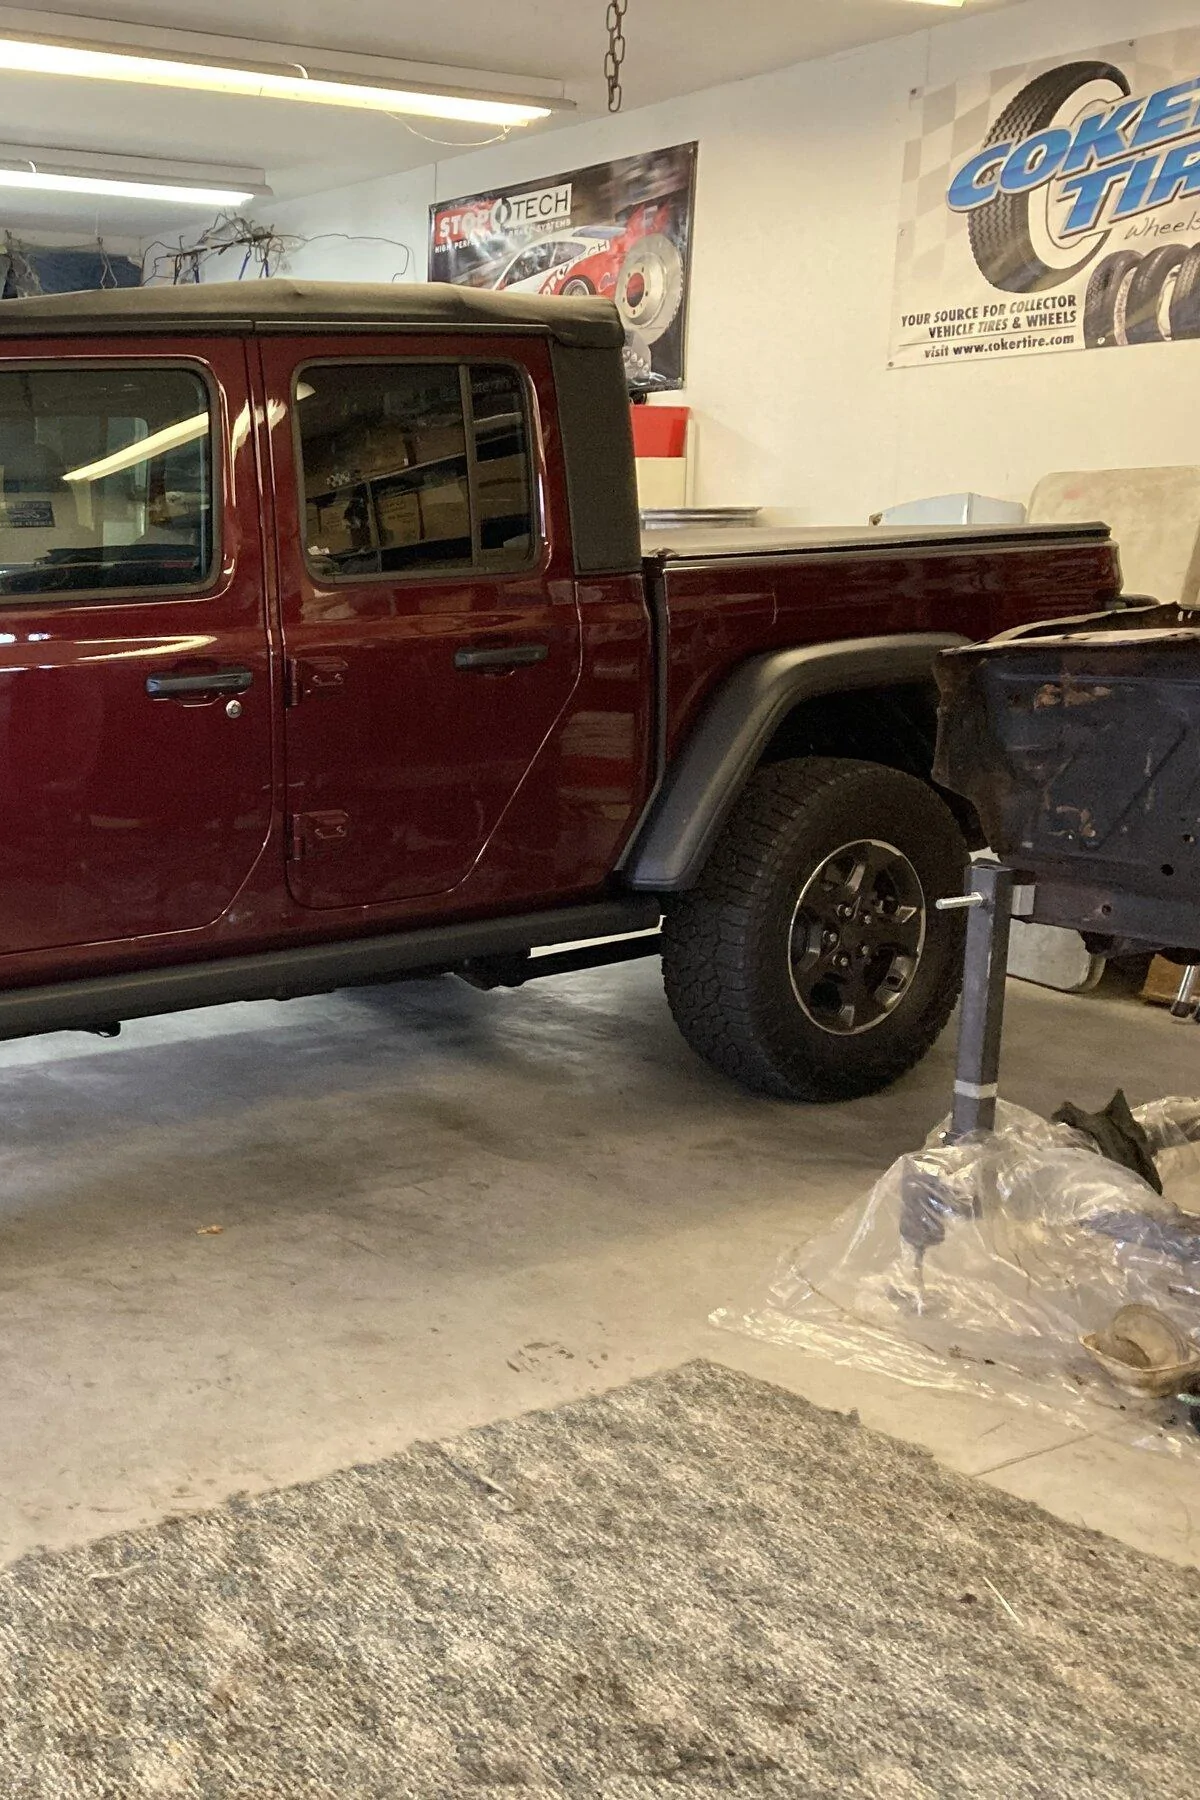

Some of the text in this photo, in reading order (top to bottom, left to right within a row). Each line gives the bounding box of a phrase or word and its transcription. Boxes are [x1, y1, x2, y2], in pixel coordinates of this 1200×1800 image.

[901, 294, 1077, 328] YOUR SOURCE FOR COLLECTOR
[928, 310, 1077, 339] VEHICLE TIRES & WHEELS
[924, 333, 1075, 359] visit www.cokertire.com
